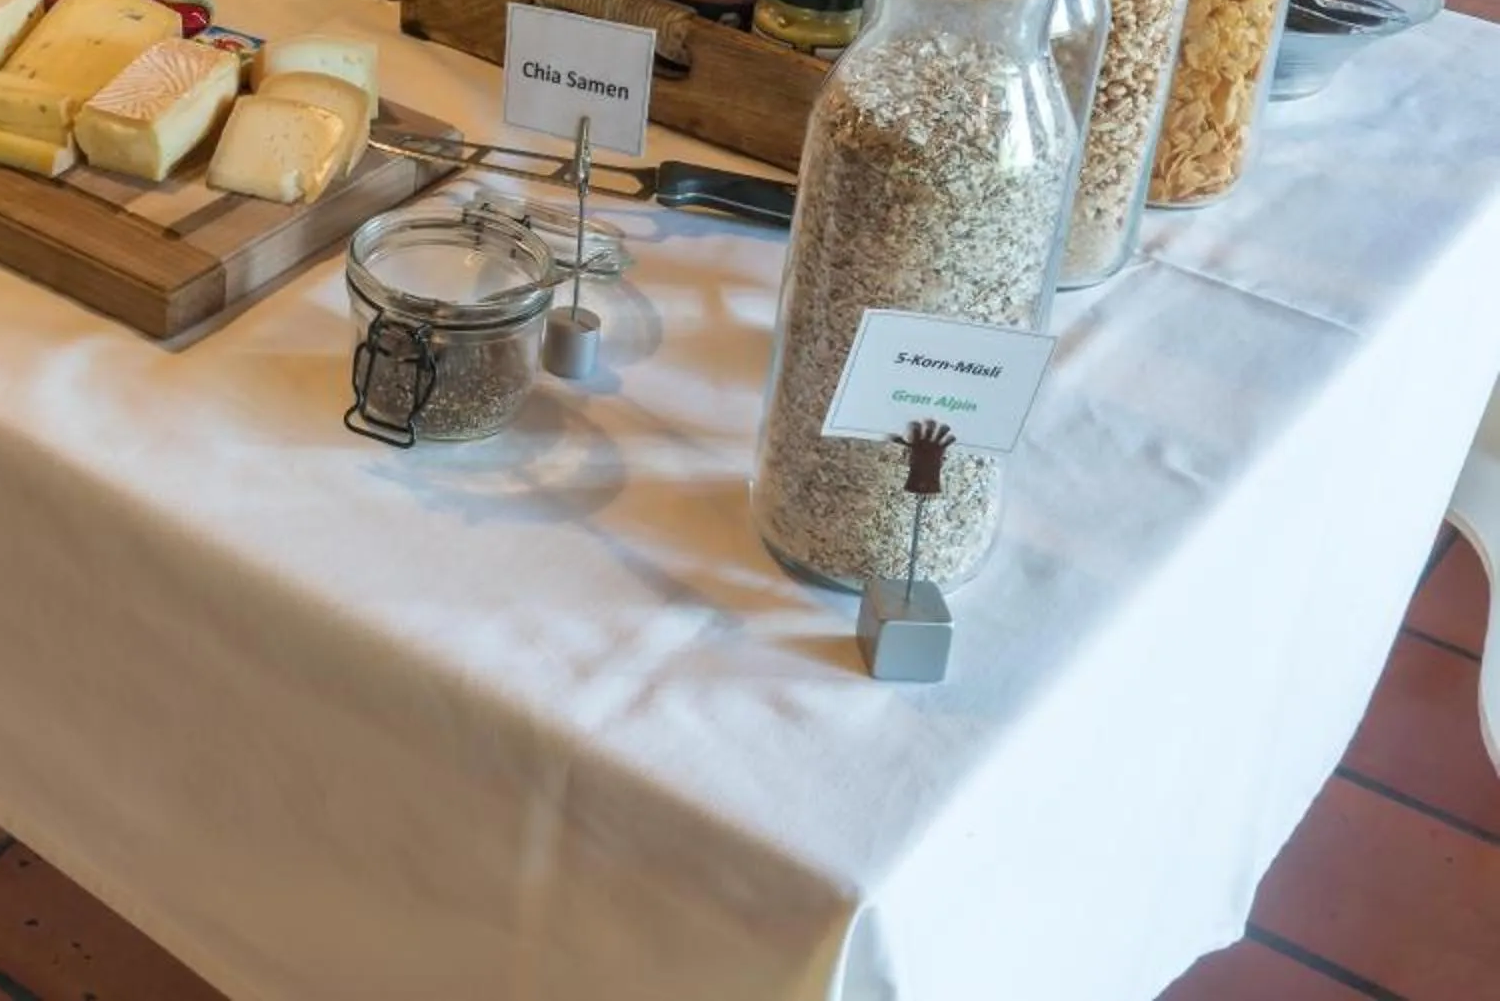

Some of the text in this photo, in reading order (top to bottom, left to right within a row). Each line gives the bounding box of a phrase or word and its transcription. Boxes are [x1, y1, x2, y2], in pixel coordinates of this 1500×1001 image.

[522, 61, 629, 100] Chia Samen
[893, 352, 1004, 378] 5-Korn-Müsli
[891, 389, 978, 412] Gran Alpin
